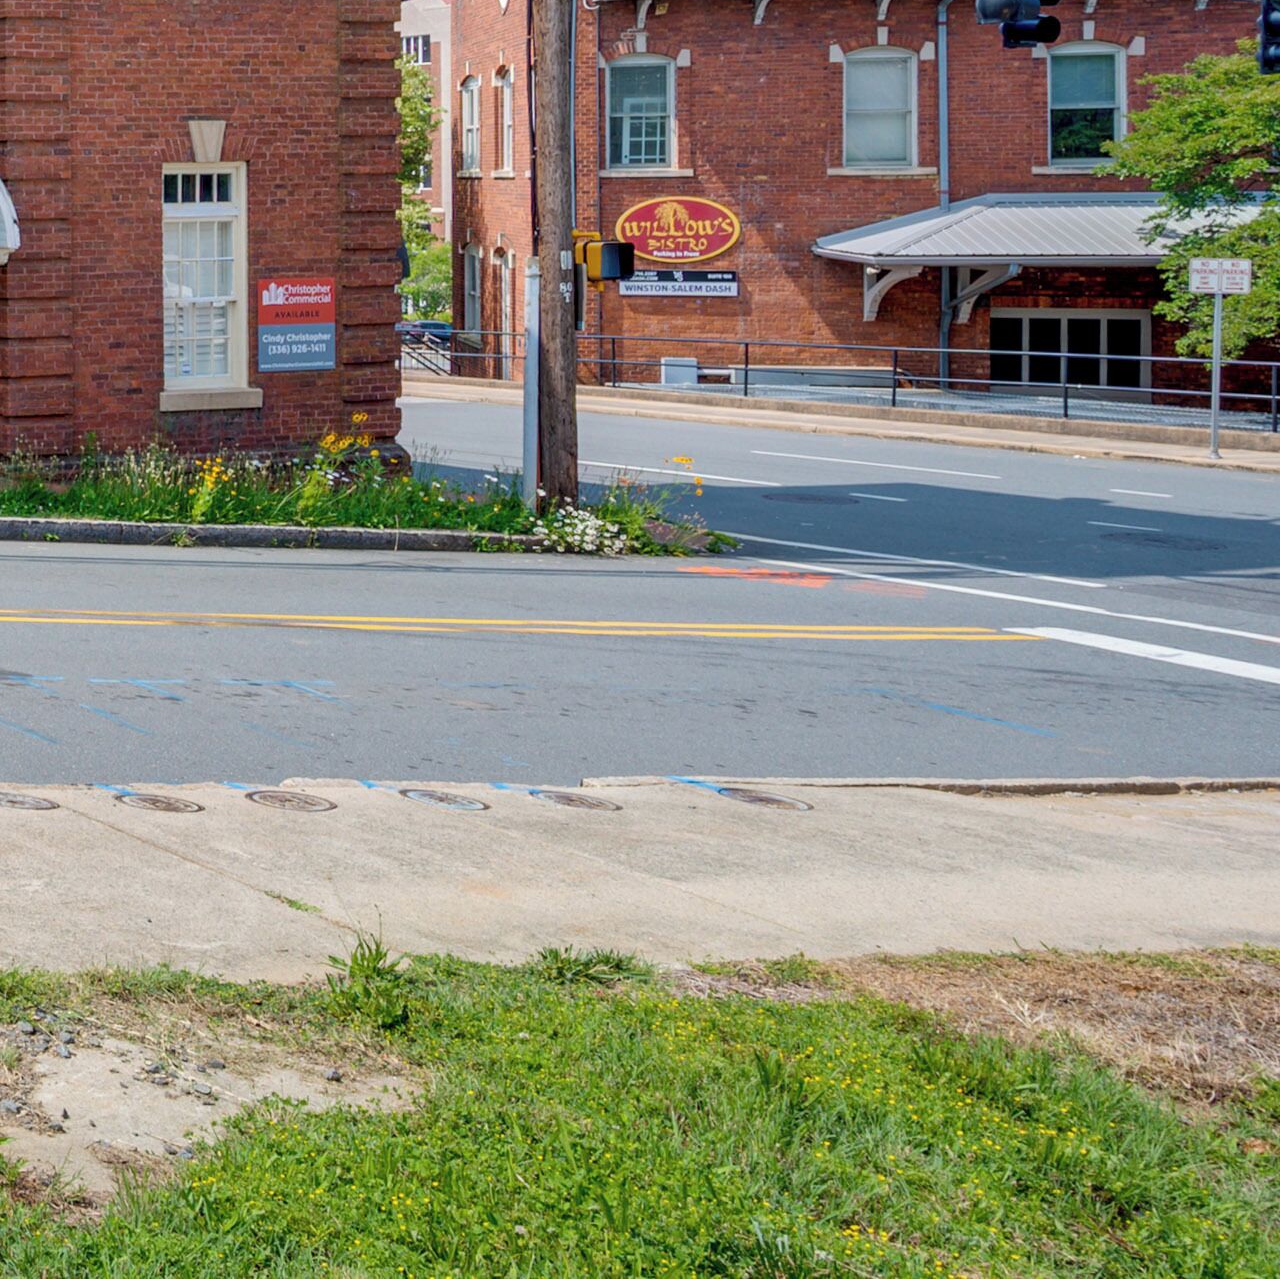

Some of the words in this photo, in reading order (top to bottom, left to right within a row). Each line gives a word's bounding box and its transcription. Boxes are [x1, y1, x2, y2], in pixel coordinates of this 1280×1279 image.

[648, 238, 708, 251] BISTRO
[283, 284, 331, 295] Christopher
[624, 284, 703, 293] WINSTON-SALEM
[705, 285, 732, 293] DASH
[283, 294, 331, 304] Commercial
[274, 310, 320, 319] AVAILABLE
[262, 334, 285, 345] Cindy
[286, 332, 331, 342] Christopher
[268, 345, 290, 355] (336)
[292, 343, 326, 354] 926-1411
